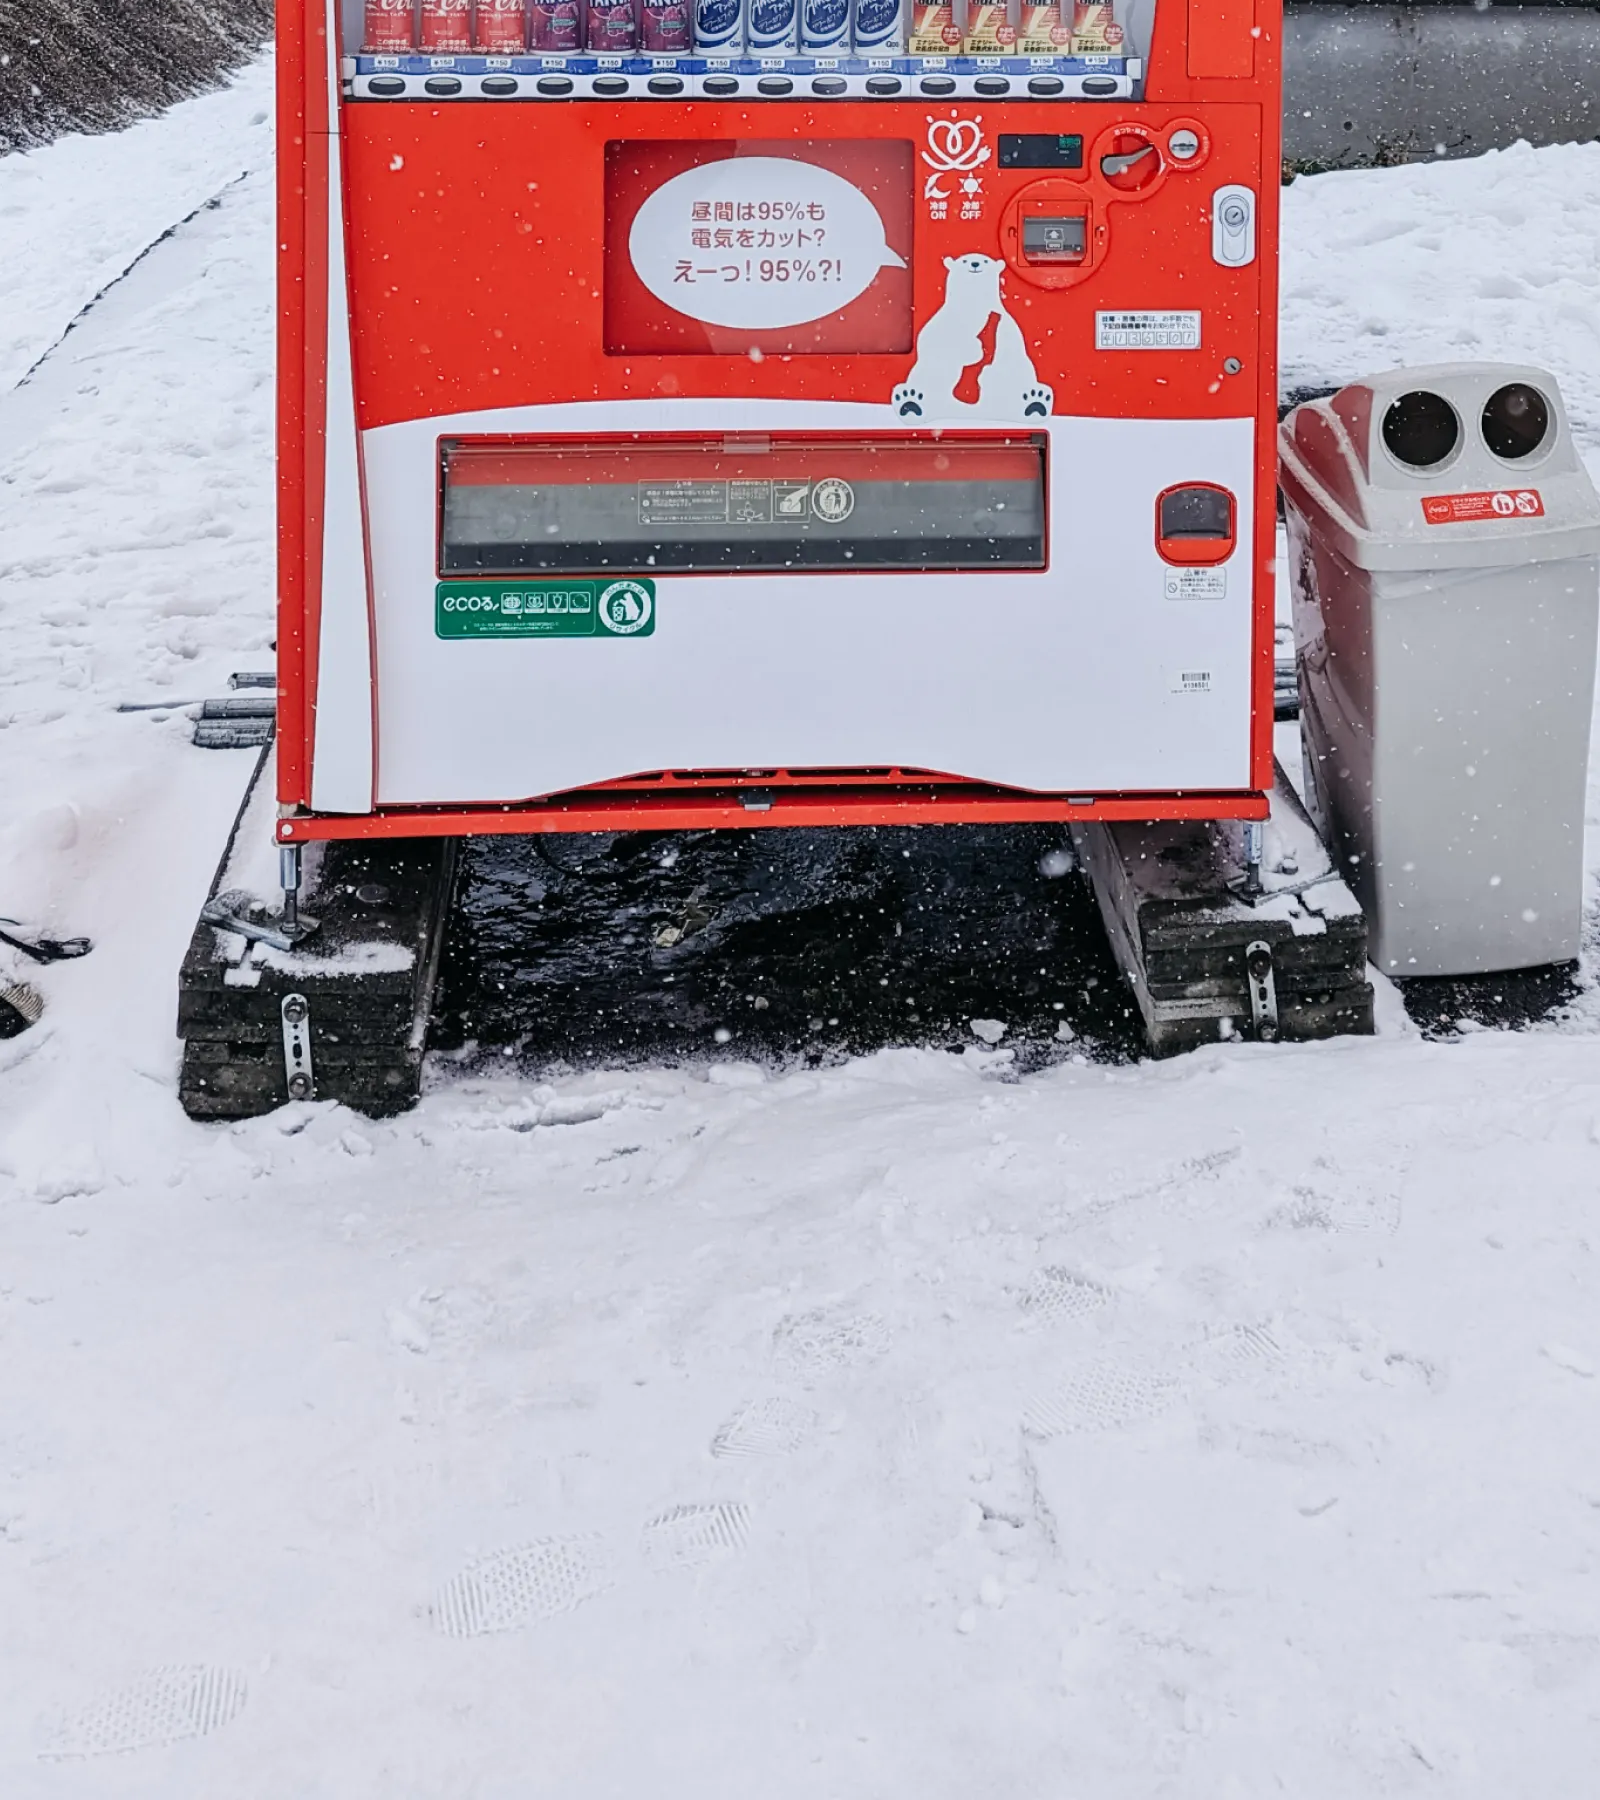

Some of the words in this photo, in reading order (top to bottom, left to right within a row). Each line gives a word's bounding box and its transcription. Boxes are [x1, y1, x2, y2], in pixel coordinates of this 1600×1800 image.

[691, 201, 825, 222] 昼間は95%も
[930, 210, 946, 220] ON
[960, 210, 982, 220] OFF
[691, 228, 826, 248] 電気をカット?
